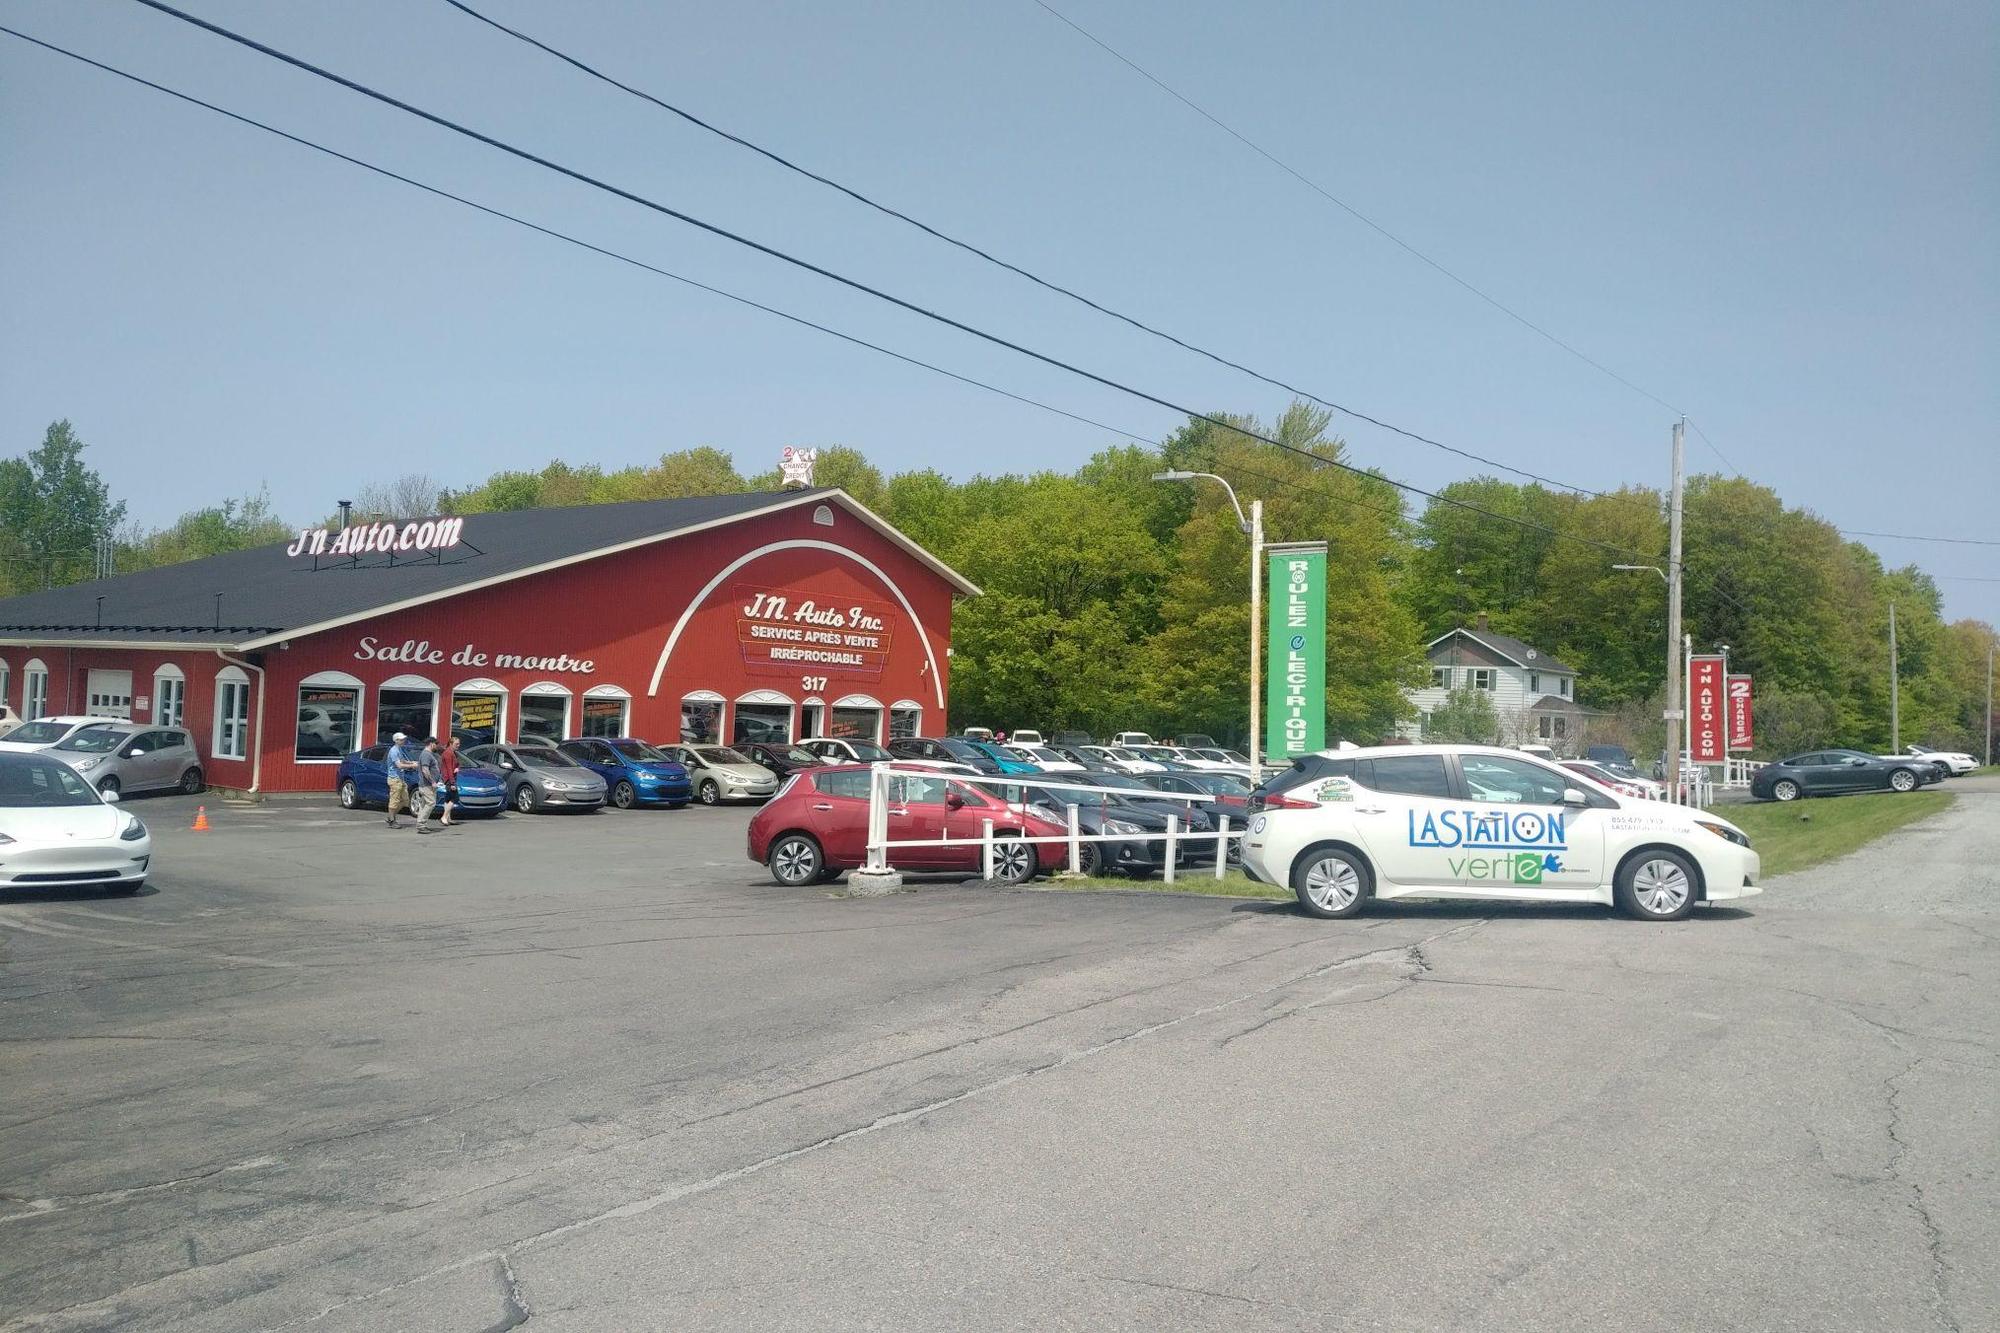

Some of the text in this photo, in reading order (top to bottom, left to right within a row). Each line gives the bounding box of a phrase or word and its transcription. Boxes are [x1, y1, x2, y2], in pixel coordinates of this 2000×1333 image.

[744, 593, 884, 631] J.N. Auto Inc.
[751, 625, 879, 648] SERVICE APRÈS VENTE
[353, 636, 596, 674] Salle de montre
[770, 647, 863, 665] IRRÉPROCHABLE
[802, 676, 828, 691] 317
[1731, 682, 1750, 697] 2
[1736, 697, 1746, 732] CHANCE
[1448, 852, 1540, 881] verte
